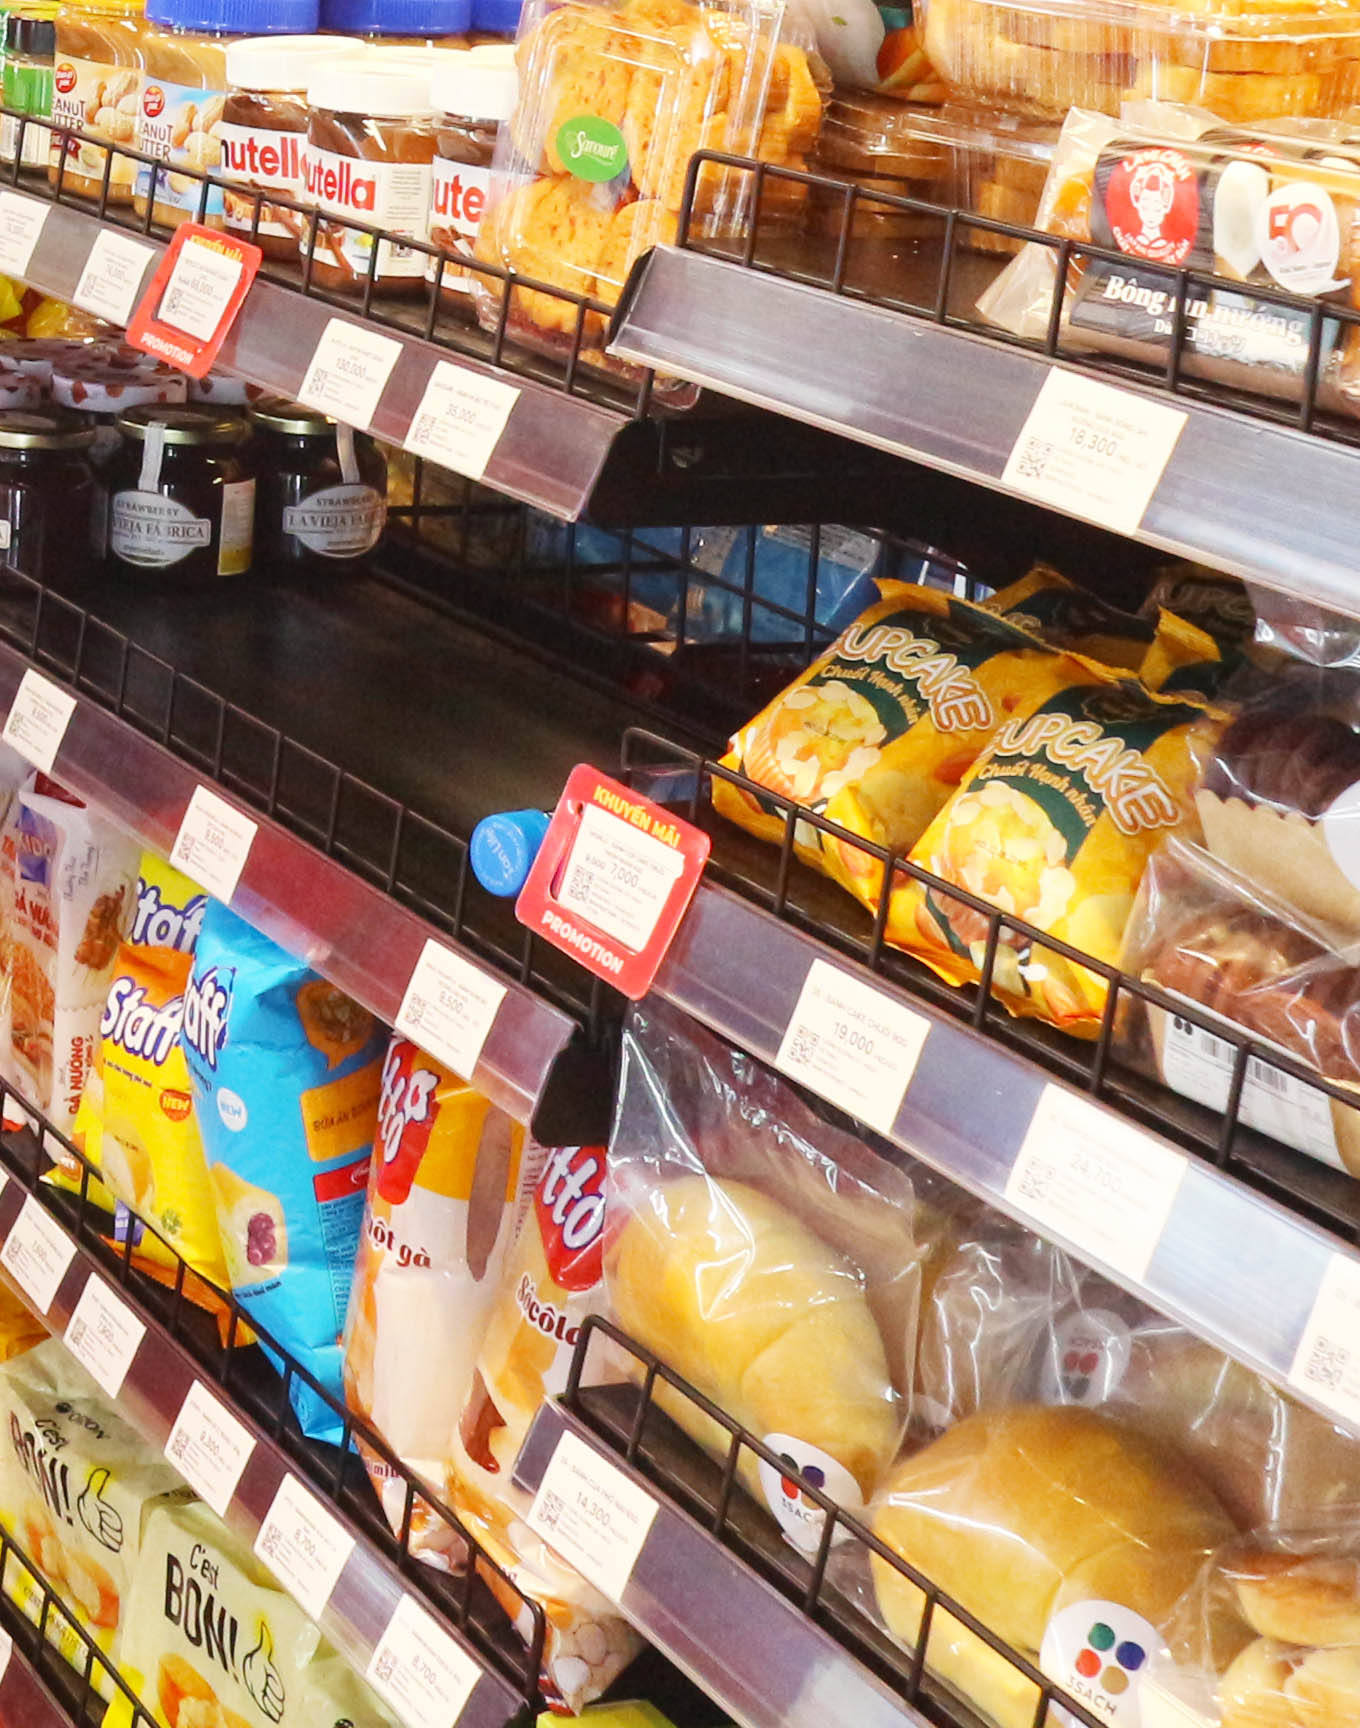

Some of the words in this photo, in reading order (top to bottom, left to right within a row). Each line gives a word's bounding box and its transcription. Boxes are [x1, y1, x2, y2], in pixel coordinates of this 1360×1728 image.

[52, 114, 85, 131] UTTER
[138, 138, 172, 162] UTTER
[303, 160, 377, 212] utella
[1103, 275, 1168, 316] Bông
[140, 332, 195, 366] PROMOTION
[1069, 426, 1118, 458] 18,300
[593, 784, 653, 832] KHUYẾN
[651, 821, 682, 848] MÃI
[609, 863, 639, 889] 7,000
[540, 909, 625, 975] PROMOTION
[833, 1022, 875, 1056] 19,000
[160, 1094, 191, 1111] NEW
[396, 1241, 431, 1270] gà
[781, 1496, 813, 1526] 3SAC
[189, 1544, 221, 1591] C'est
[163, 1551, 239, 1685] BON!
[1067, 1674, 1117, 1716] 3SACH
